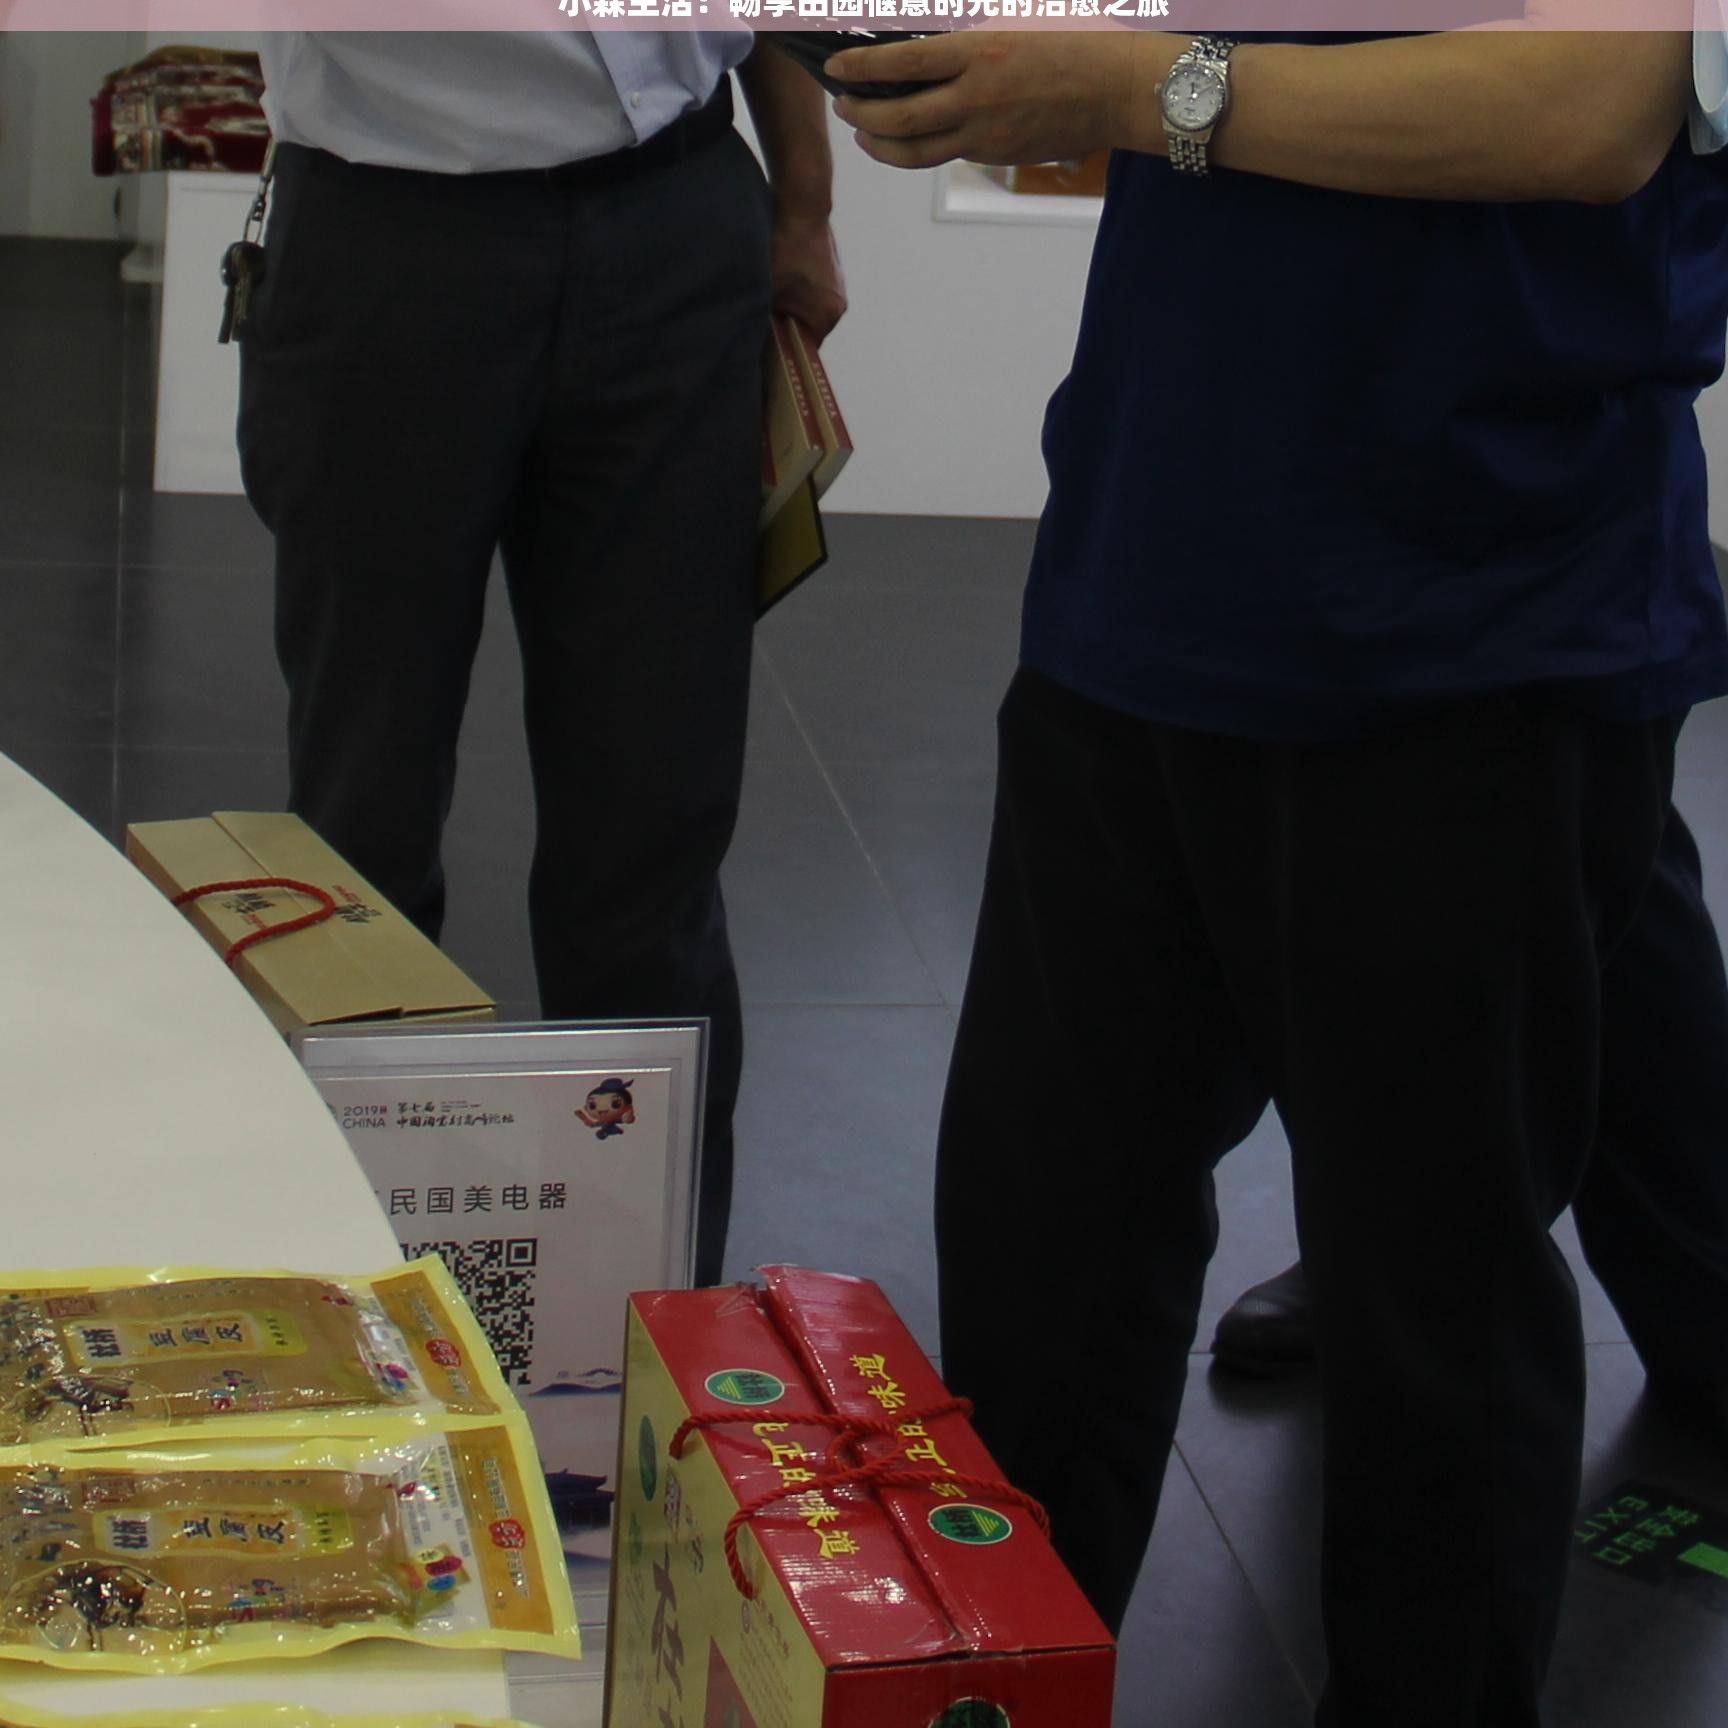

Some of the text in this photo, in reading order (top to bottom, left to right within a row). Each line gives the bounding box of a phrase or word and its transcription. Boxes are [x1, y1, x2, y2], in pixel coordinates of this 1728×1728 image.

[343, 1117, 385, 1129] CHINA
[373, 1182, 567, 1215] 民国美电器
[148, 1322, 243, 1349] 豆腐皮
[184, 1518, 286, 1548] 豆腐皮
[1573, 1495, 1649, 1543] EXIT
